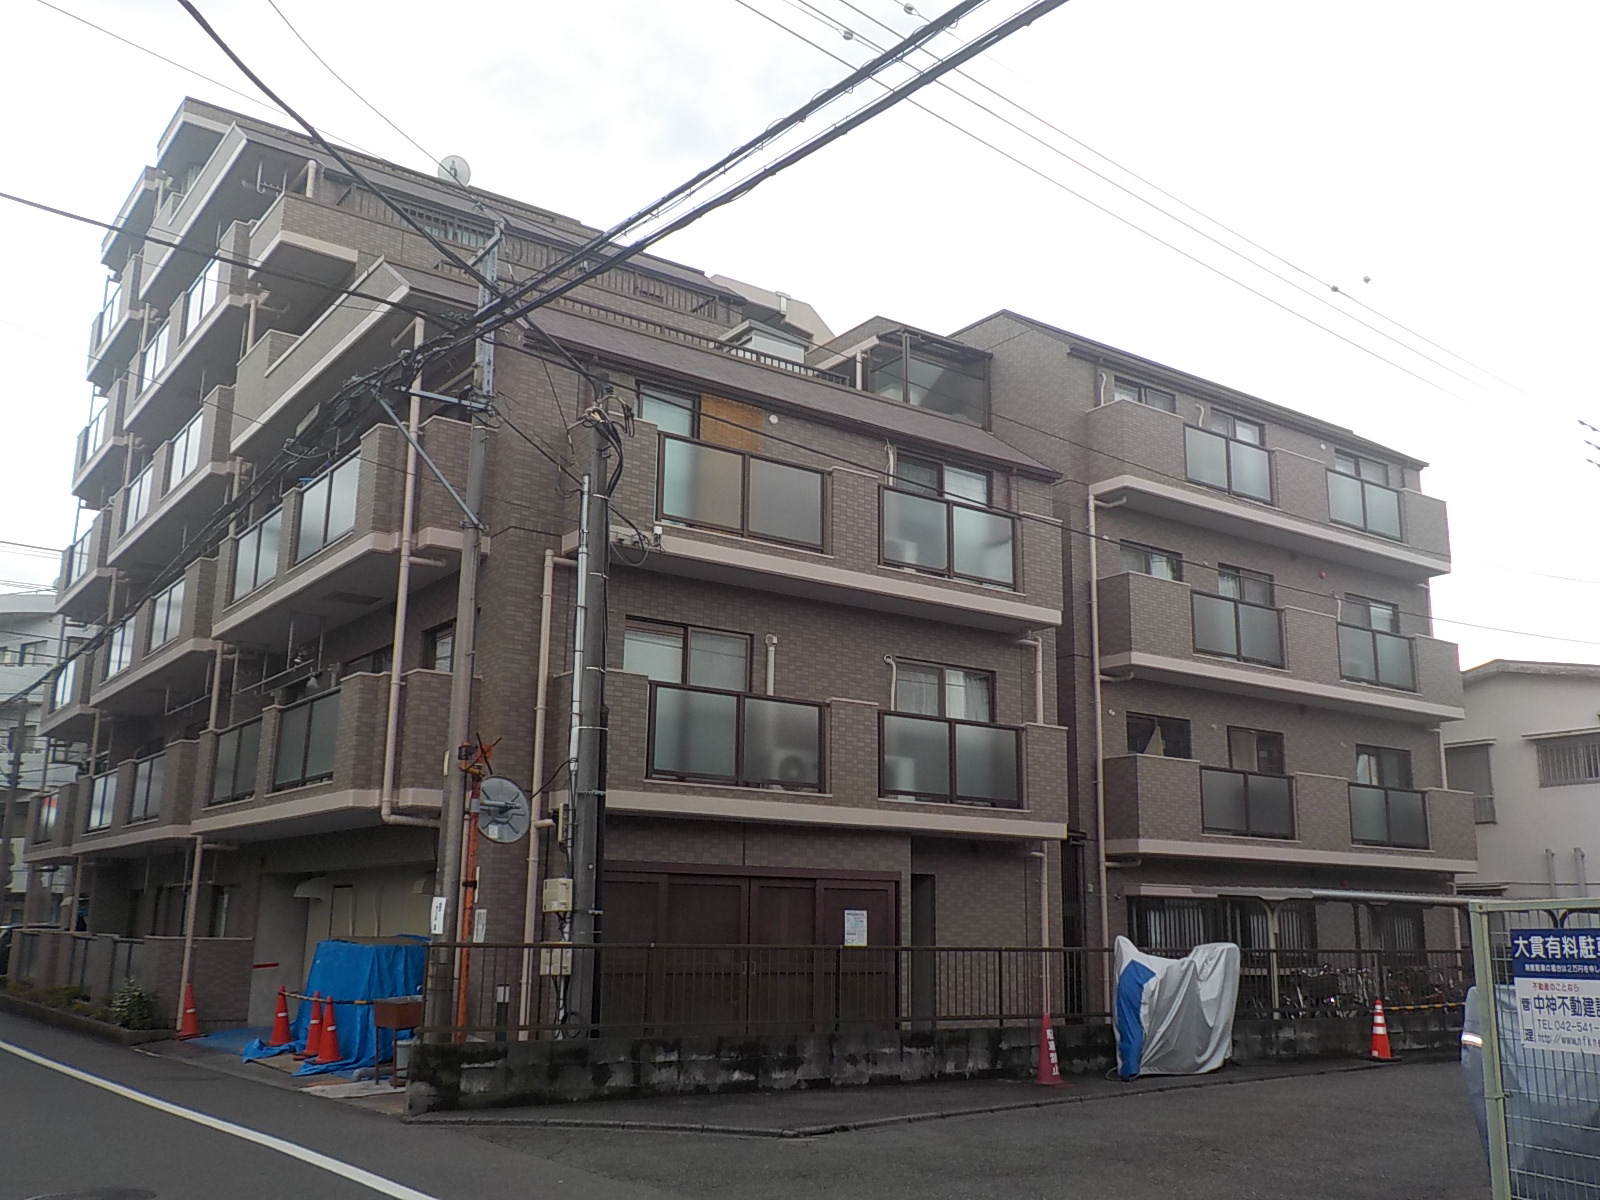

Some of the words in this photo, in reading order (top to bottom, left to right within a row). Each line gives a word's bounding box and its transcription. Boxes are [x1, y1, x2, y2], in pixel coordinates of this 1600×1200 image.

[1514, 935, 1600, 959] 大貫有料駐
[1537, 1019, 1553, 1030] TEL
